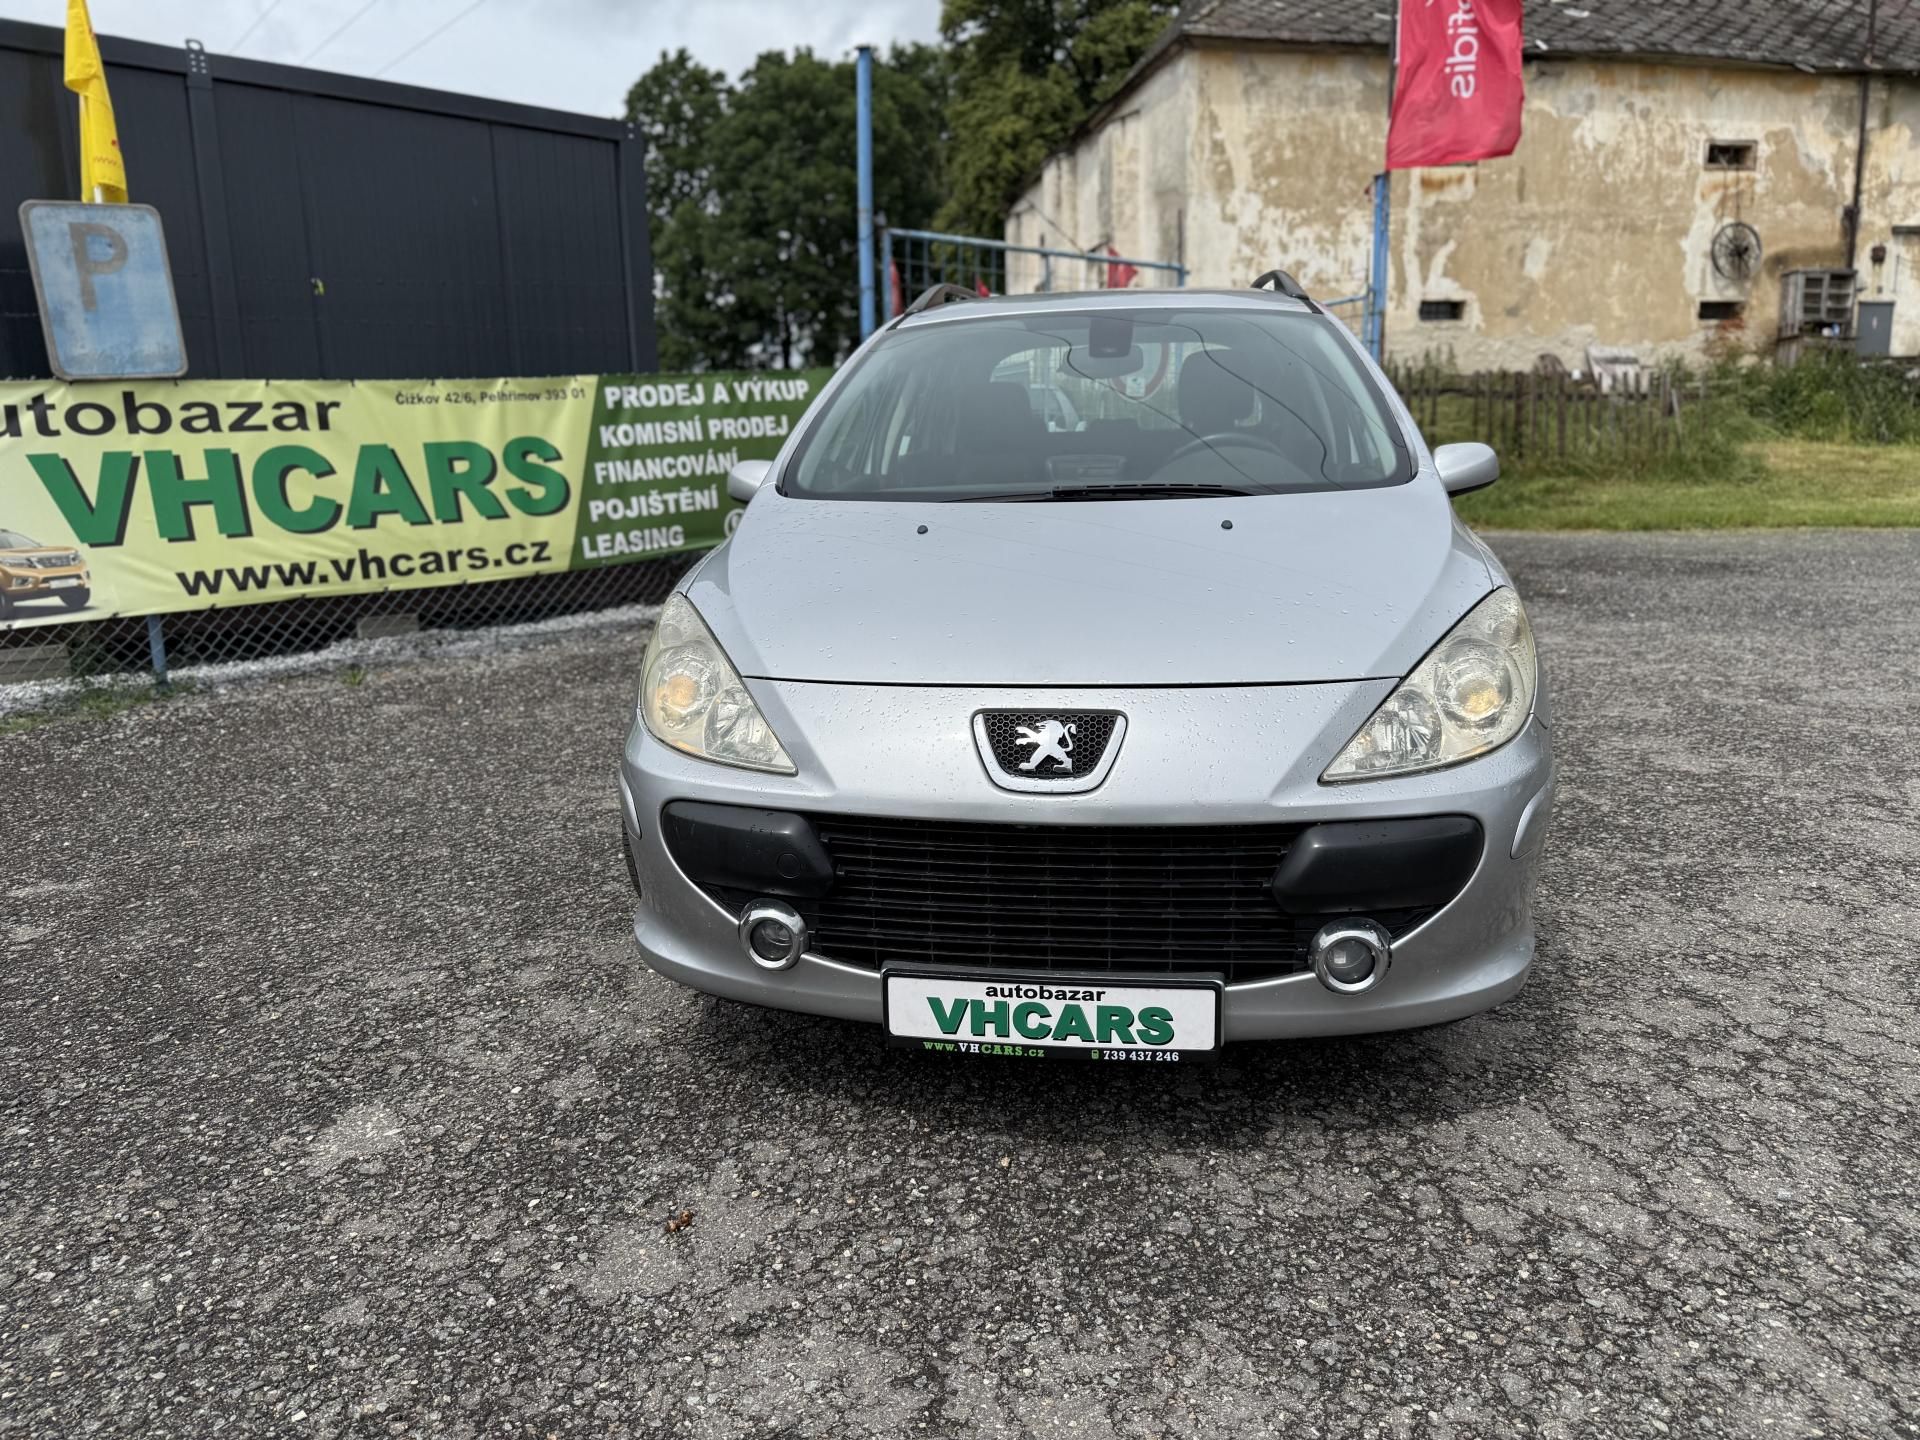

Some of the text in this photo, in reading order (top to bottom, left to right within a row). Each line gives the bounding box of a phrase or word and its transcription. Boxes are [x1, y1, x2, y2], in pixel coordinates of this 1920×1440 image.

[67, 222, 128, 312] P
[545, 388, 567, 402] 393
[571, 387, 586, 400] 01
[604, 376, 809, 409] PRODEJ A VÝKUP
[600, 414, 788, 448] KOMISNÍ PRODEJ
[594, 446, 738, 485] FINANCOVÁNÍ
[26, 435, 570, 549] VHCARS
[588, 483, 719, 523] POJIŠTĚNÍ
[581, 524, 685, 560] LEASING
[175, 539, 552, 597] www.vhcars.cz
[985, 984, 1106, 1002] autobazar
[926, 996, 1175, 1046] VHCARS
[923, 1041, 1045, 1058] www.VHCARS.cz
[1103, 1050, 1179, 1062] 739 437 246
